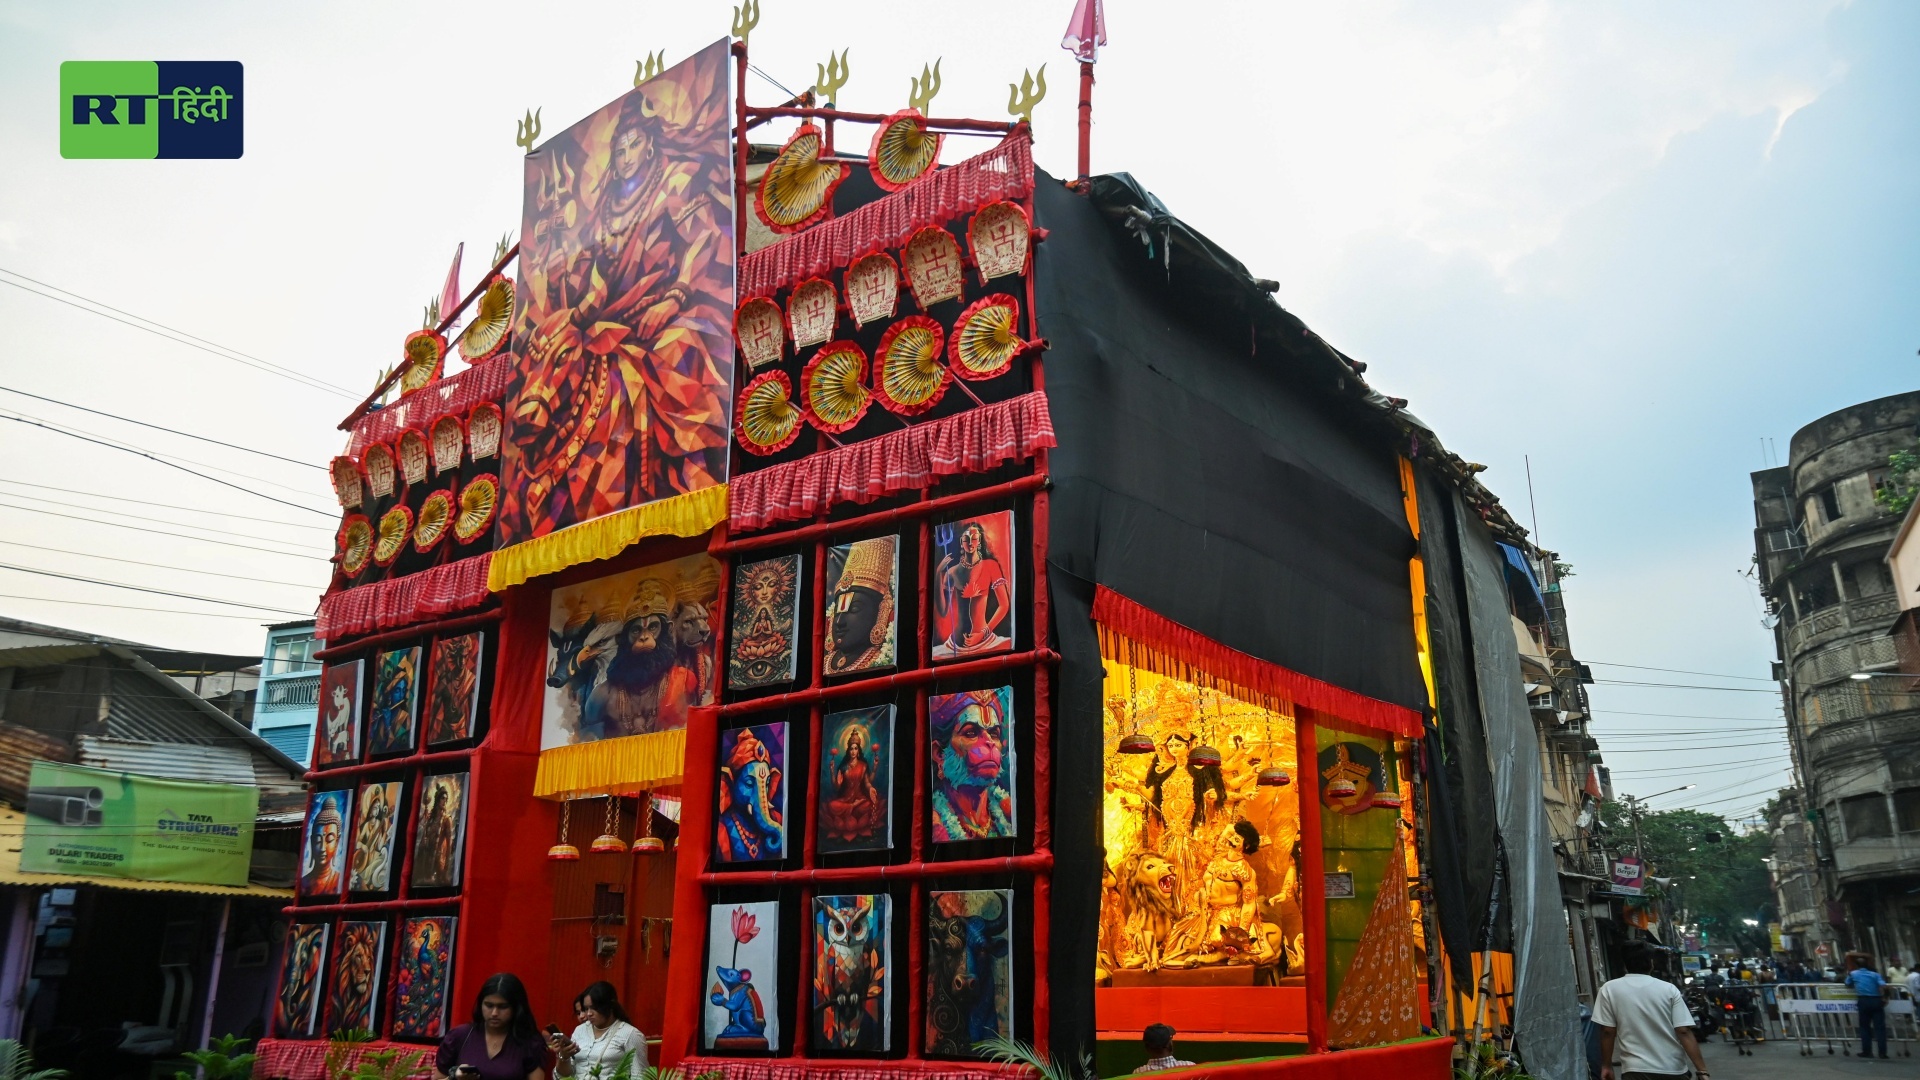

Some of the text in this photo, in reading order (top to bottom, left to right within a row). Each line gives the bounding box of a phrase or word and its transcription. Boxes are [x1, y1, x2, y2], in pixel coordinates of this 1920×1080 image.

[188, 813, 213, 823] TATA
[158, 819, 239, 837] STRUCTURA
[49, 848, 124, 861] DULARI TRADERS
